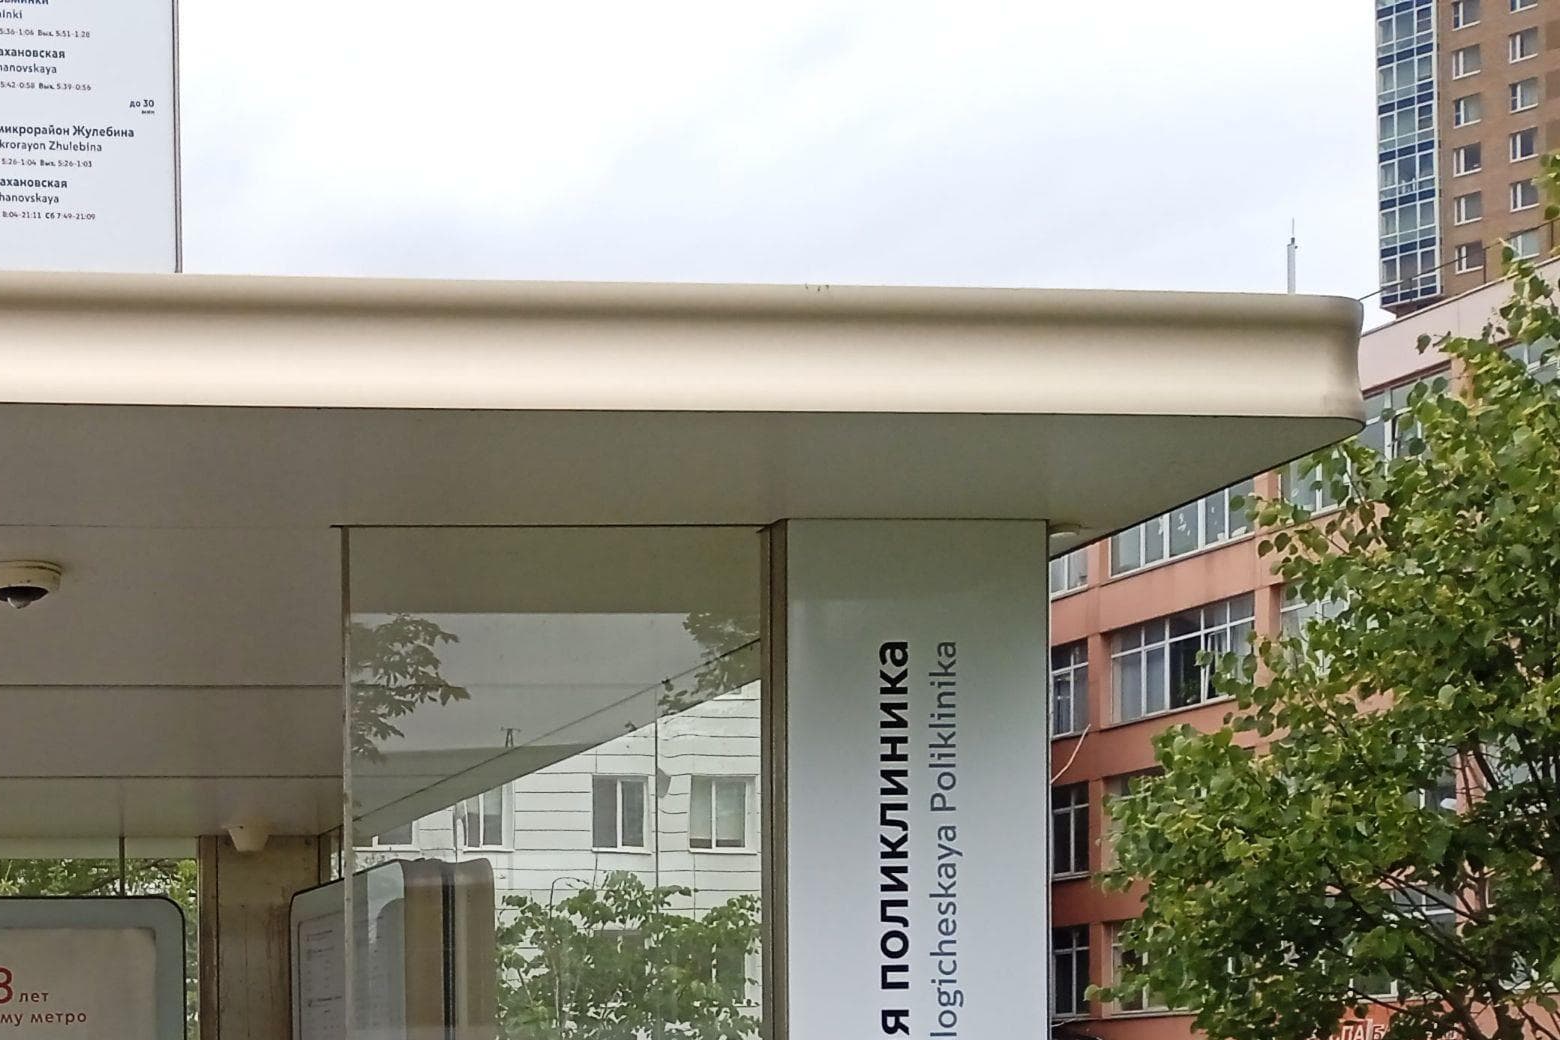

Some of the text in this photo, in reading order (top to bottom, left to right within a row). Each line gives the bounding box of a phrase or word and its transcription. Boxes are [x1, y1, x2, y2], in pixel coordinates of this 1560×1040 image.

[129, 99, 155, 109] до 30
[72, 125, 135, 138] Жулебина
[48, 140, 102, 152] Zhulebina
[929, 641, 957, 812] Poliklinika
[879, 641, 909, 991] поликлиника
[18, 992, 49, 1003] лет
[30, 1012, 87, 1026] метро
